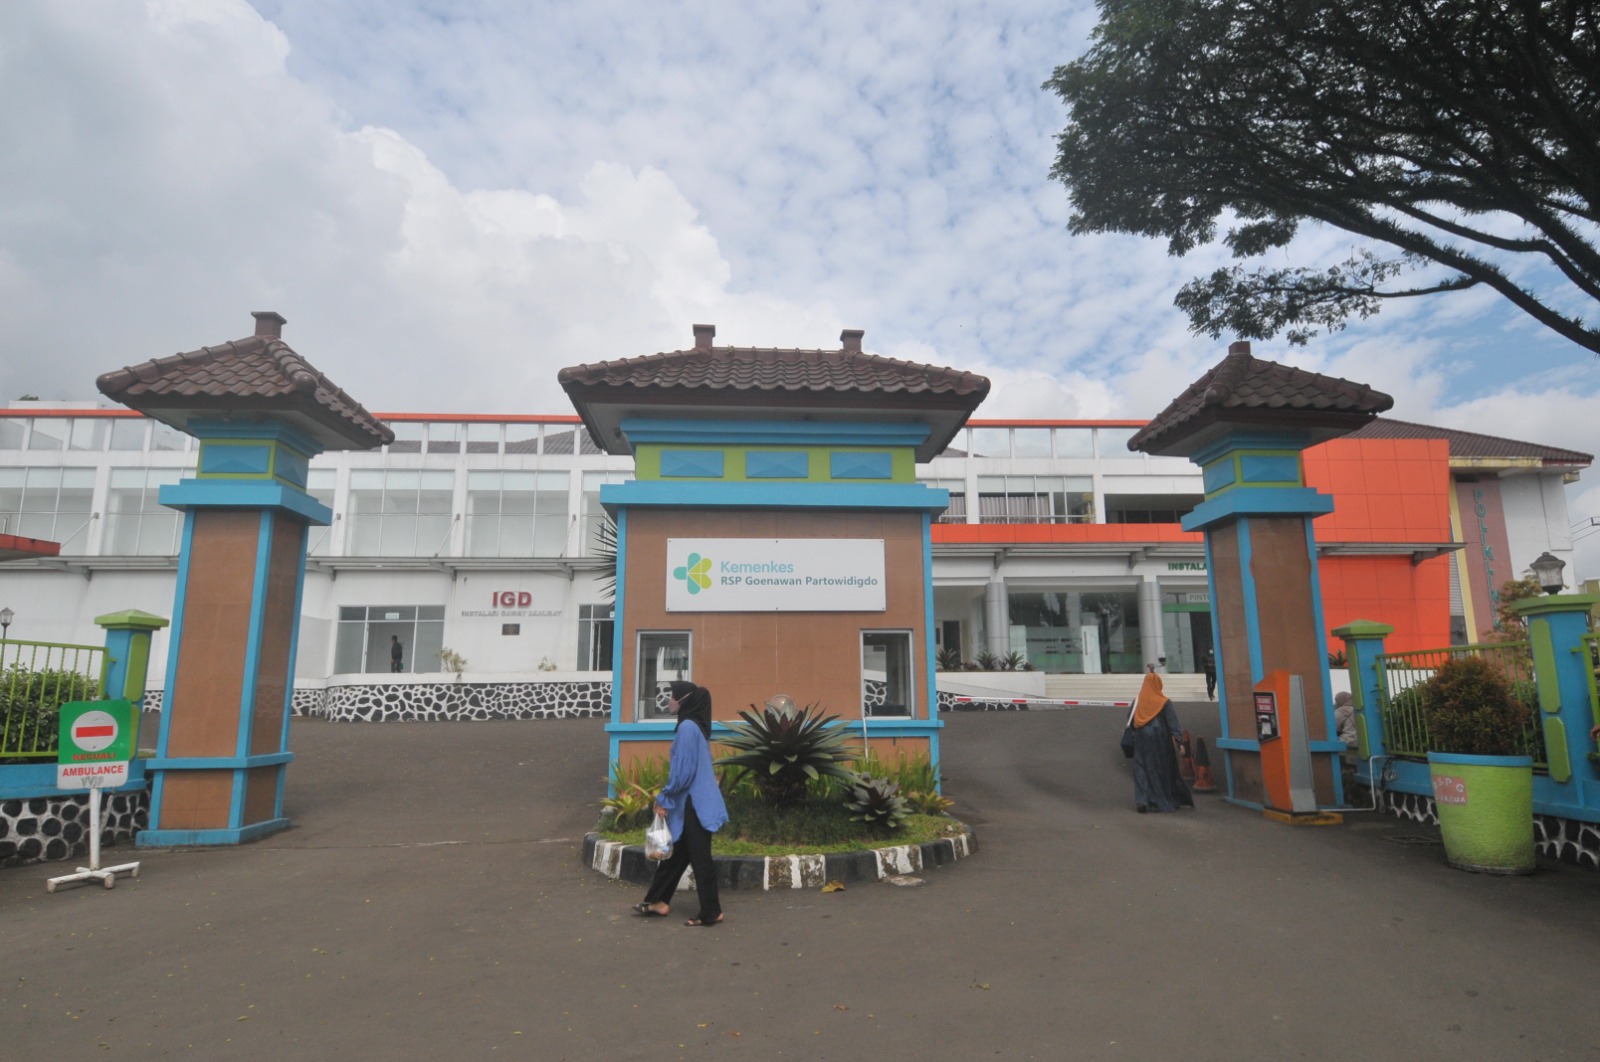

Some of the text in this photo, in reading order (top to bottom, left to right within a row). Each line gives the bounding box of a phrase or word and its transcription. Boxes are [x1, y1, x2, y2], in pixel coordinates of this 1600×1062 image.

[720, 560, 794, 573] Kemenkes
[720, 576, 878, 588] RSP Goenawan Partowidigdo
[492, 591, 532, 607] IGD
[63, 765, 123, 776] AMBULANCE
